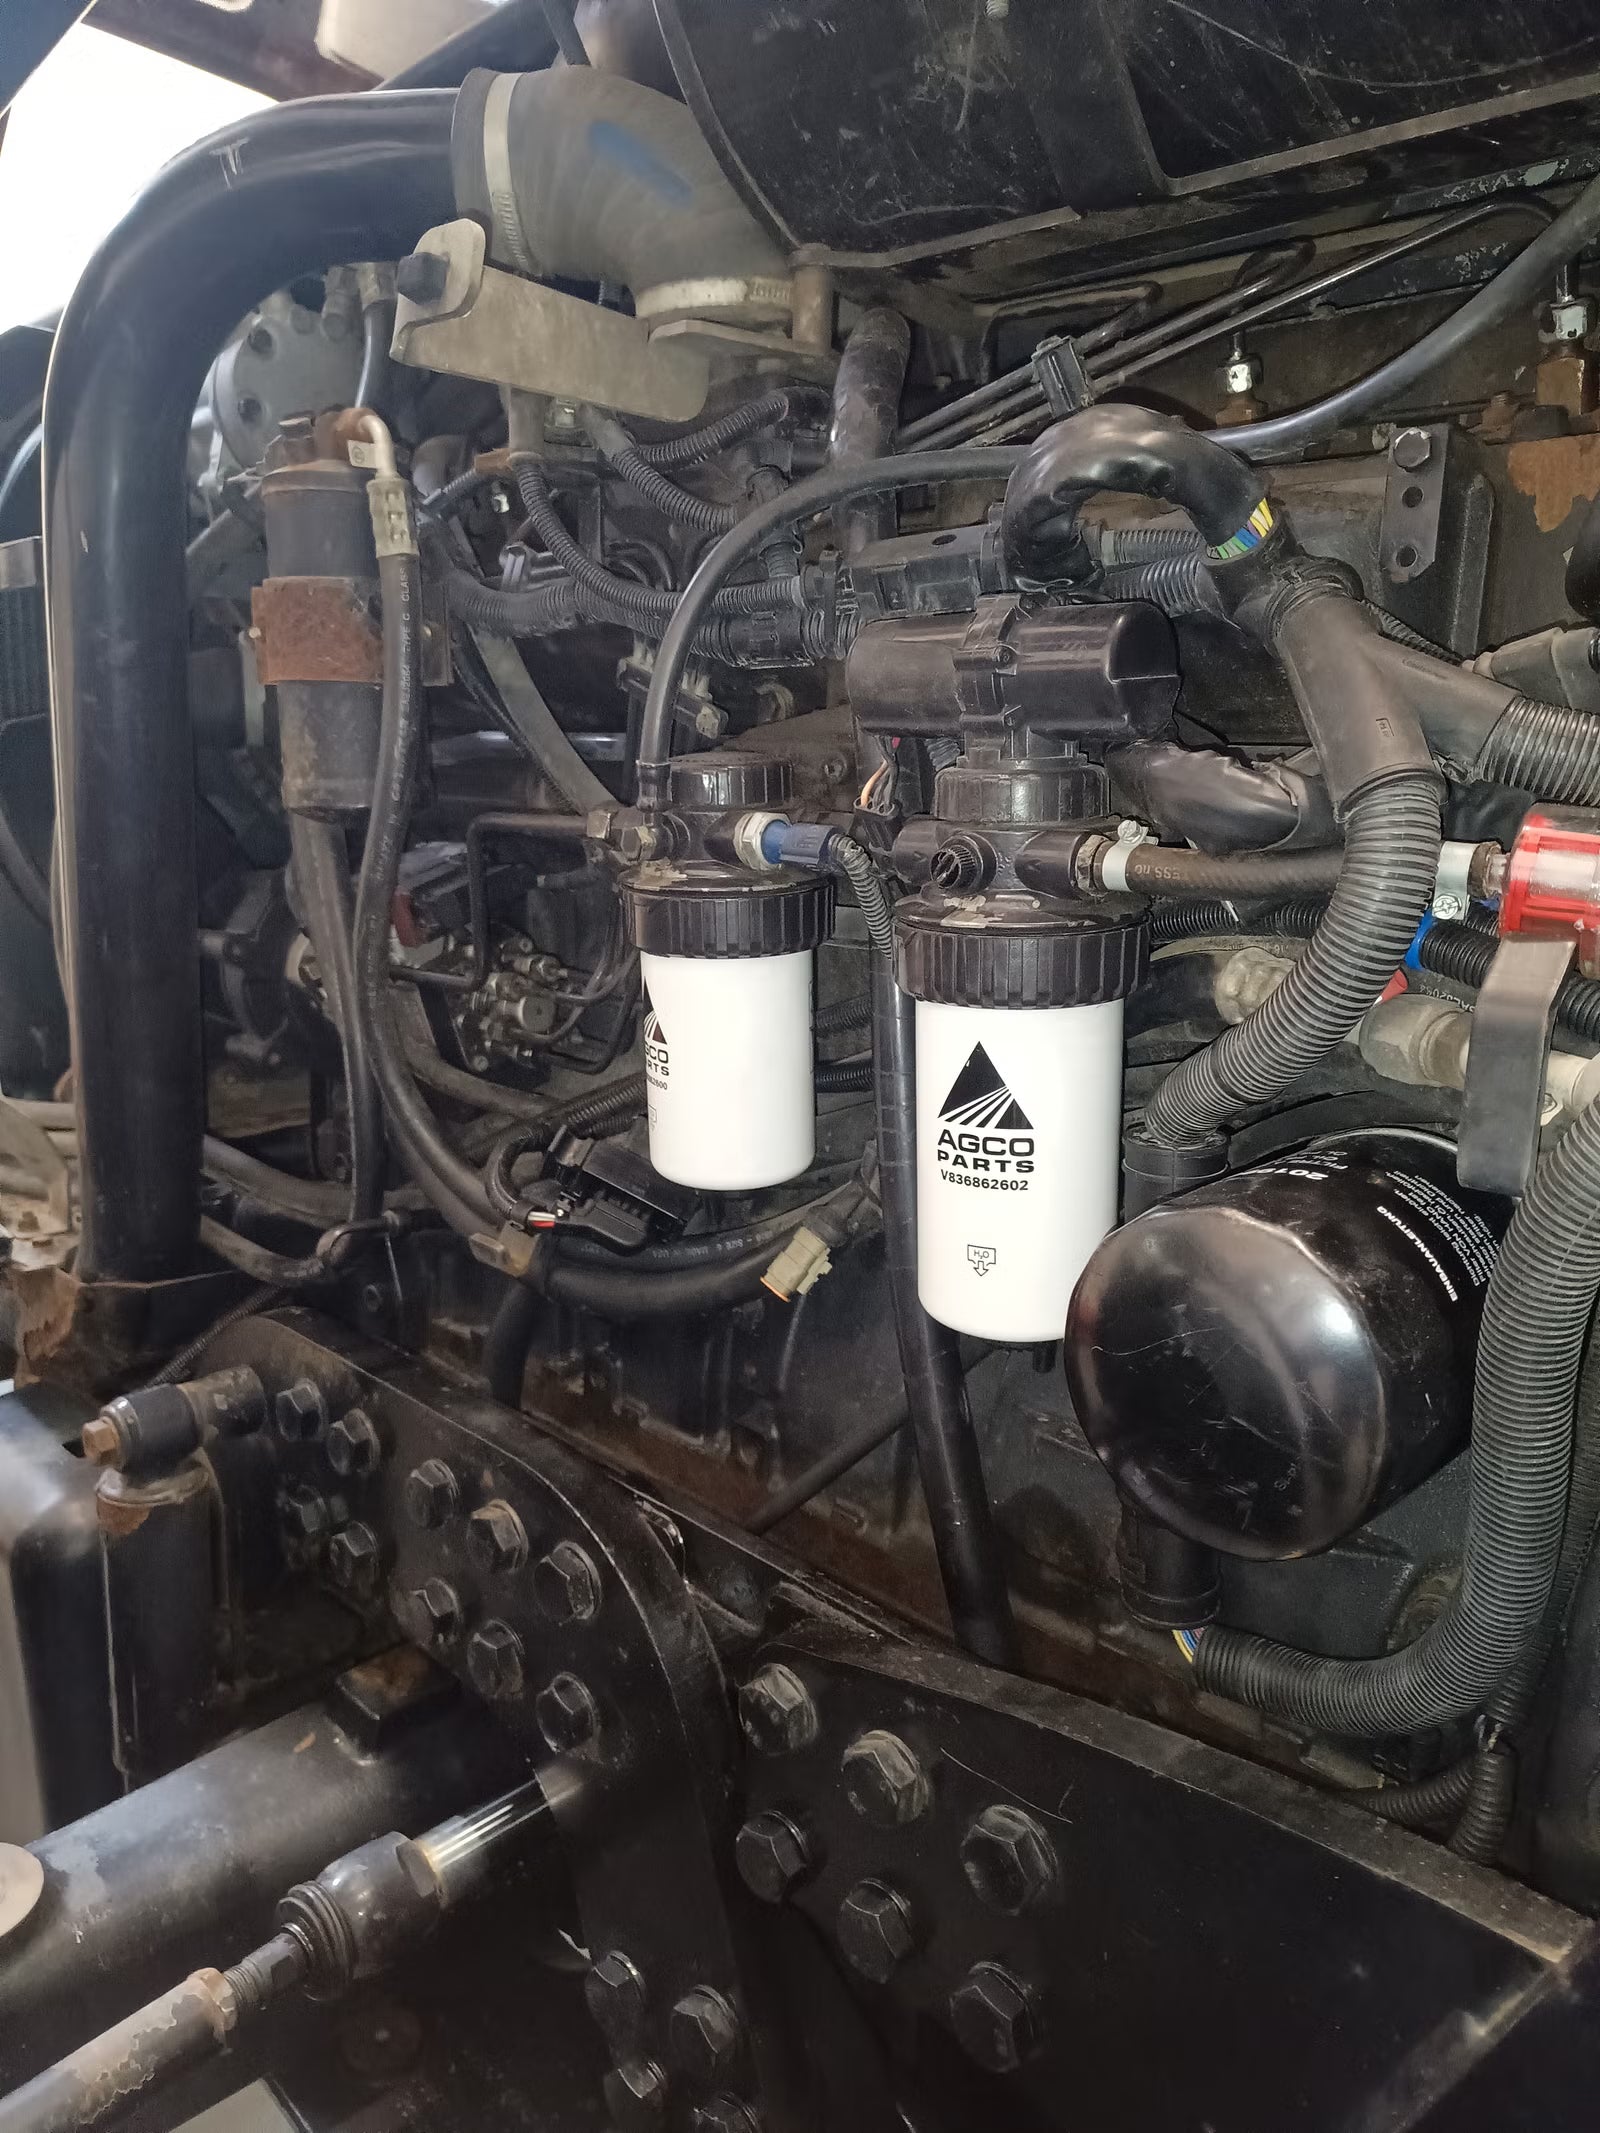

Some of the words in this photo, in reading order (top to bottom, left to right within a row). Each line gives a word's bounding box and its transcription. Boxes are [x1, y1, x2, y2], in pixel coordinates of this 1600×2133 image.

[938, 1129, 1035, 1157] AGCO
[937, 1149, 1035, 1174] PARTS
[940, 1168, 1029, 1191] V836862602
[1408, 1192, 1426, 1206] fest
[1435, 1197, 1453, 1213] und
[1427, 1207, 1453, 1232] HAND
[1429, 1217, 1452, 1241] leicht
[1377, 1205, 1458, 1302] EINBAUANLEITUNG
[1452, 1233, 1470, 1256] VON
[1451, 1241, 1480, 1286] Dichtung
[1470, 1258, 1486, 1282] Filter
